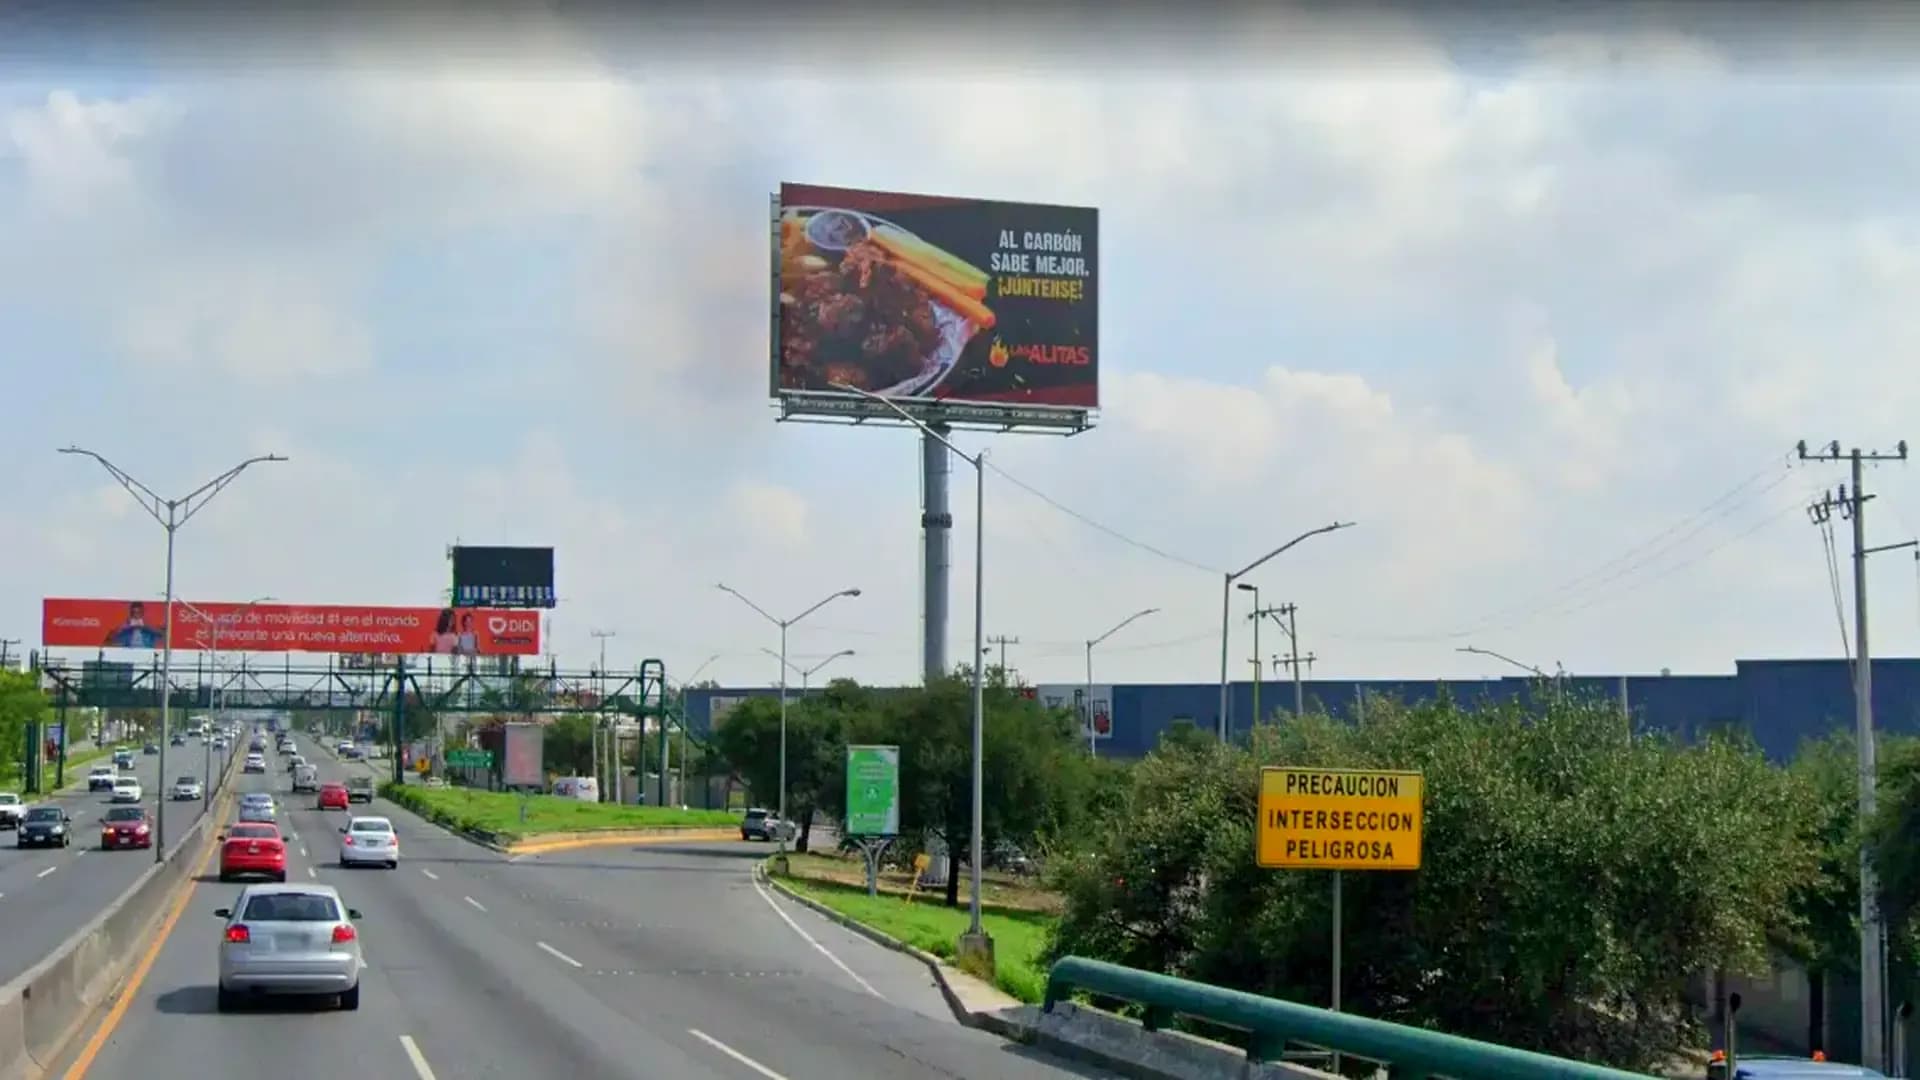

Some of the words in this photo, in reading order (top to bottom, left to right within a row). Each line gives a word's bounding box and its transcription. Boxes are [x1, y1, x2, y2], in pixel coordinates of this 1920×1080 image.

[999, 229, 1018, 249] AL
[1023, 228, 1082, 252] CARBÓN
[990, 252, 1030, 273] SABE
[1035, 255, 1090, 277] MEJOR.
[997, 274, 1083, 301] ¡JÚNTENSE!
[1029, 344, 1089, 365] ALITAS
[244, 611, 261, 624] de
[264, 611, 324, 625] movilidad
[327, 613, 339, 625] #1
[342, 615, 359, 626] en
[361, 611, 373, 627] el
[376, 613, 419, 627] mundo
[271, 631, 296, 641] una
[298, 630, 336, 642] nueva
[1286, 773, 1399, 797] PRECAUCION
[1269, 809, 1413, 832] INTERSECCION
[1286, 839, 1394, 860] PELIGROSA
